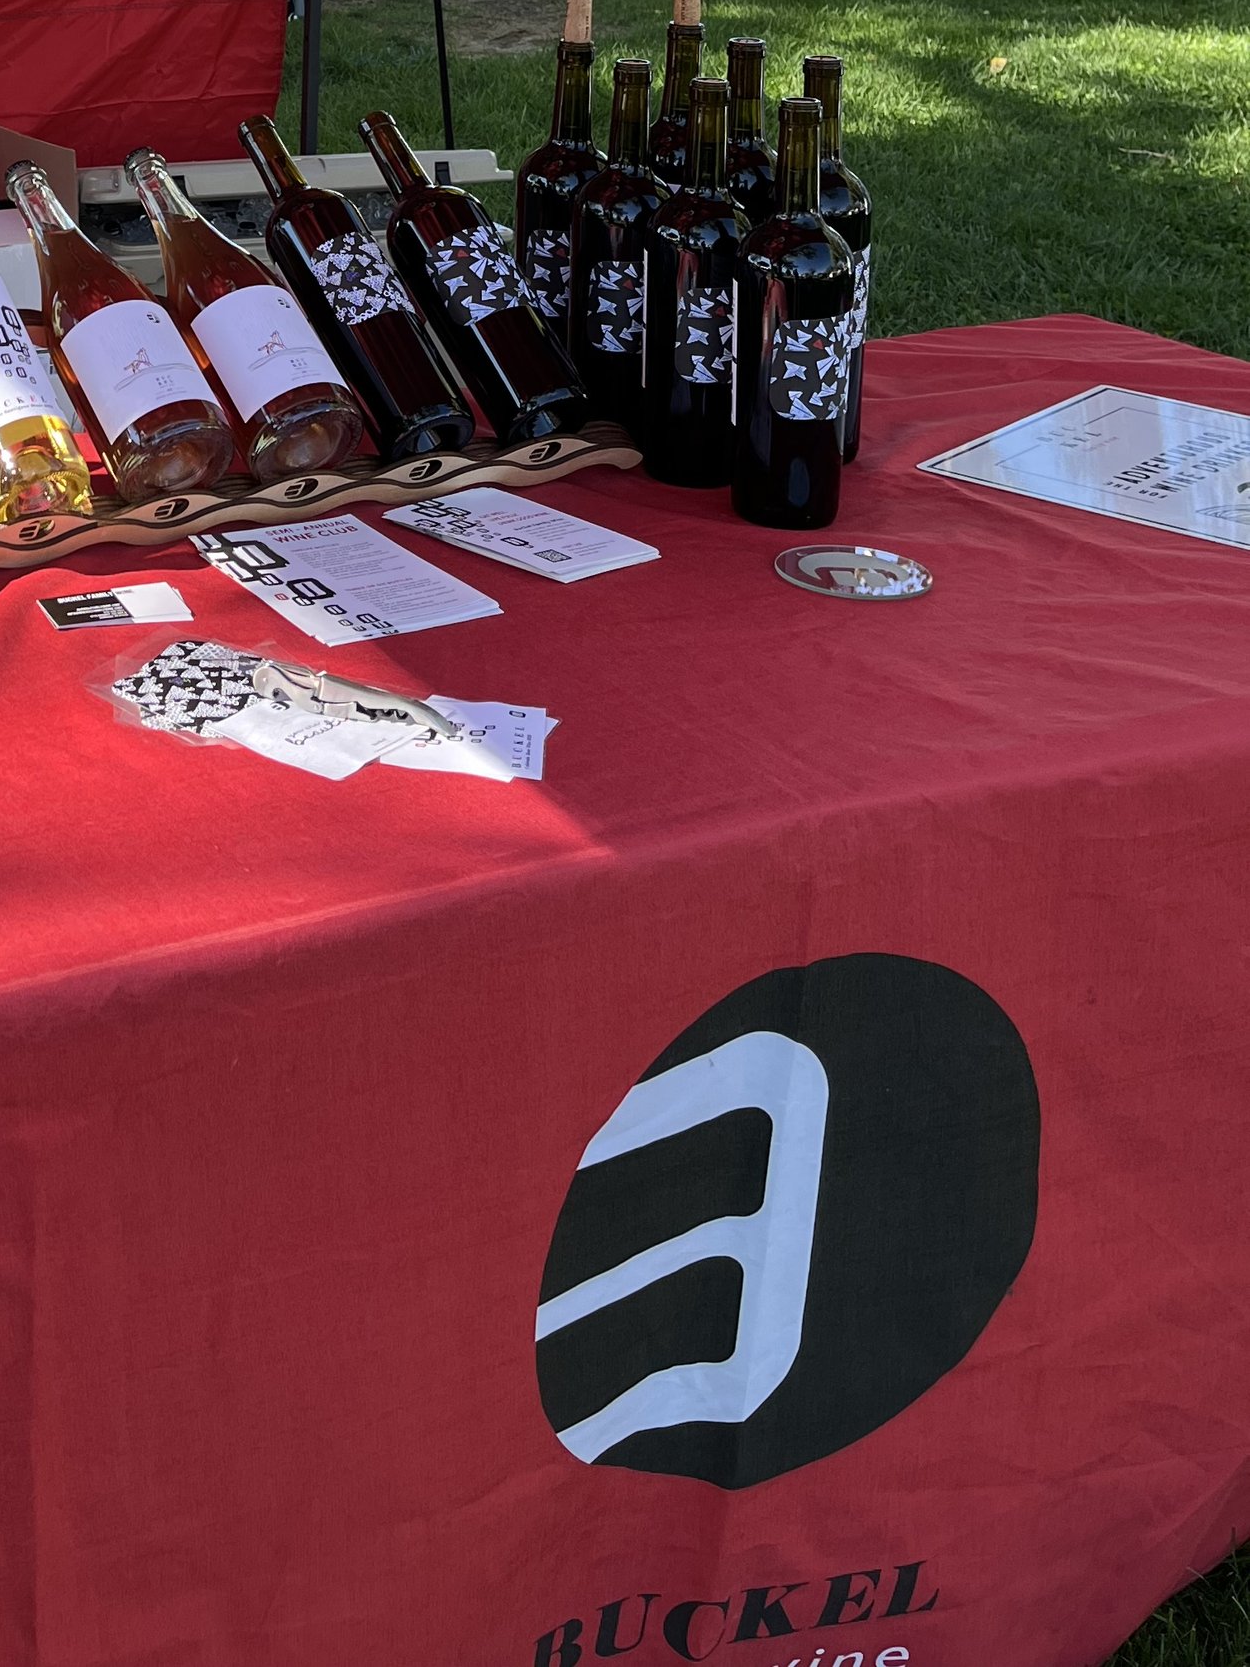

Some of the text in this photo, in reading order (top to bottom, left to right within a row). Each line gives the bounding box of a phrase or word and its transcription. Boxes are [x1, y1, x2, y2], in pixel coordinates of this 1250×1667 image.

[273, 525, 358, 543] WINE CLUB
[533, 1560, 940, 1667] BUCKEL
